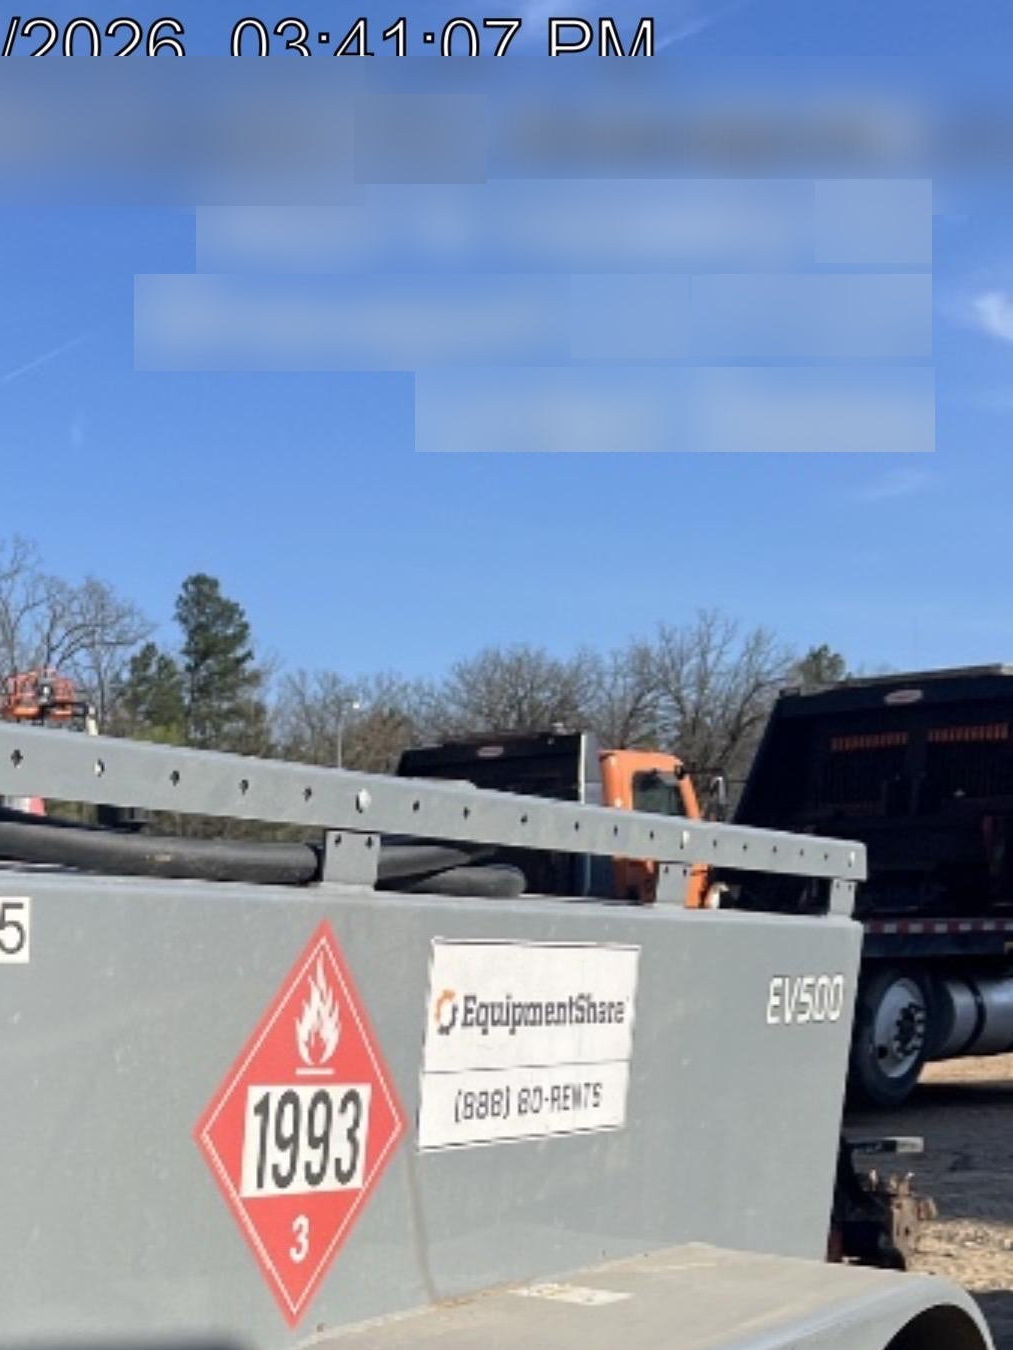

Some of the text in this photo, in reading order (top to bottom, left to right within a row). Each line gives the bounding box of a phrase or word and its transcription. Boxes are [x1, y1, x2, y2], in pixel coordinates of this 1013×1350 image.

[461, 992, 625, 1036] EquipmentShare
[767, 974, 844, 1024] EV500
[454, 1085, 511, 1124] (888)
[252, 1088, 363, 1191] 1993
[288, 1213, 311, 1264] 3
